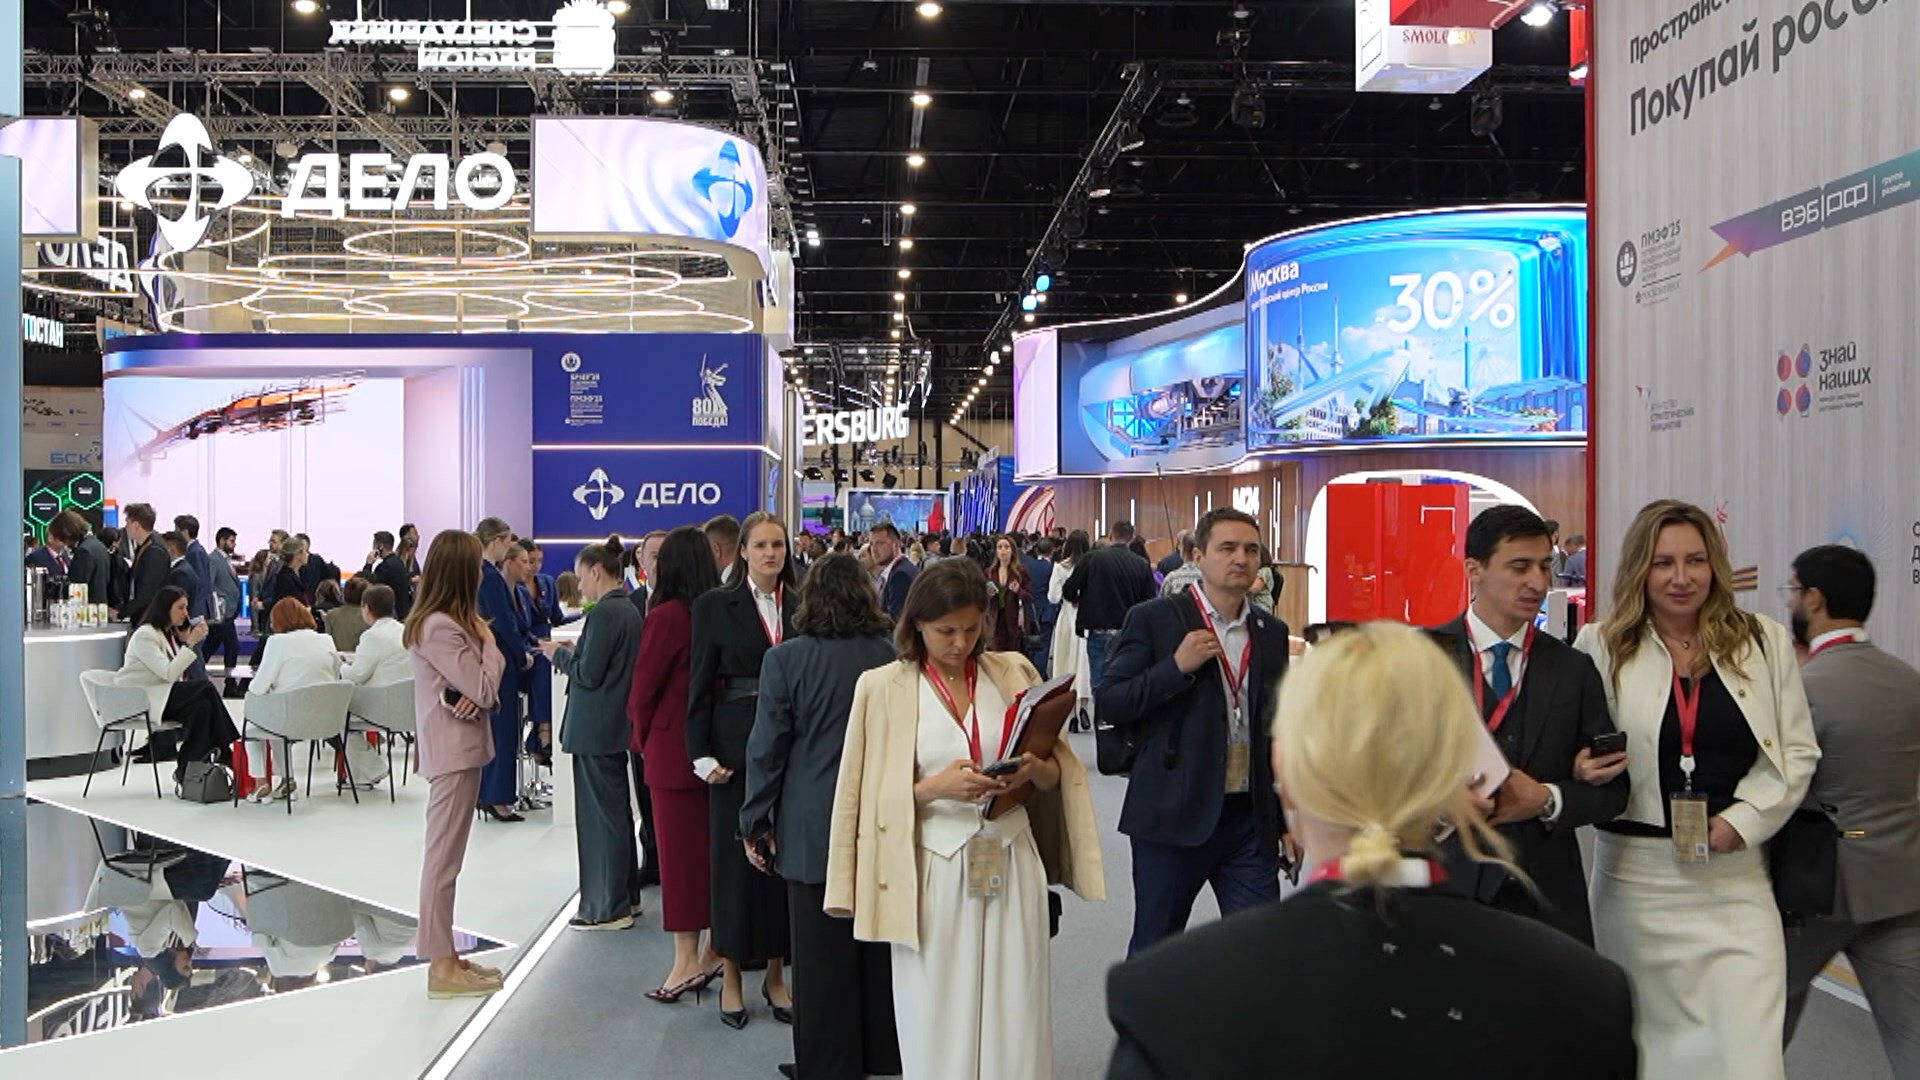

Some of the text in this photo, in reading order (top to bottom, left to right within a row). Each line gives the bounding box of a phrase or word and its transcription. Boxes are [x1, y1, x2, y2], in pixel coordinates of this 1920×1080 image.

[1402, 28, 1478, 46] SMOLESK
[1629, 0, 1731, 65] Пространс
[1630, 16, 1760, 137] Покупай
[281, 152, 517, 219] ДЕЛО
[1250, 261, 1300, 296] Москва
[1387, 269, 1517, 333] 30%
[22, 313, 64, 349] ТОСТАН
[1819, 367, 1872, 391] наших
[692, 397, 712, 415] 80
[50, 452, 92, 465] БСК
[635, 483, 721, 508] ДЕЛО
